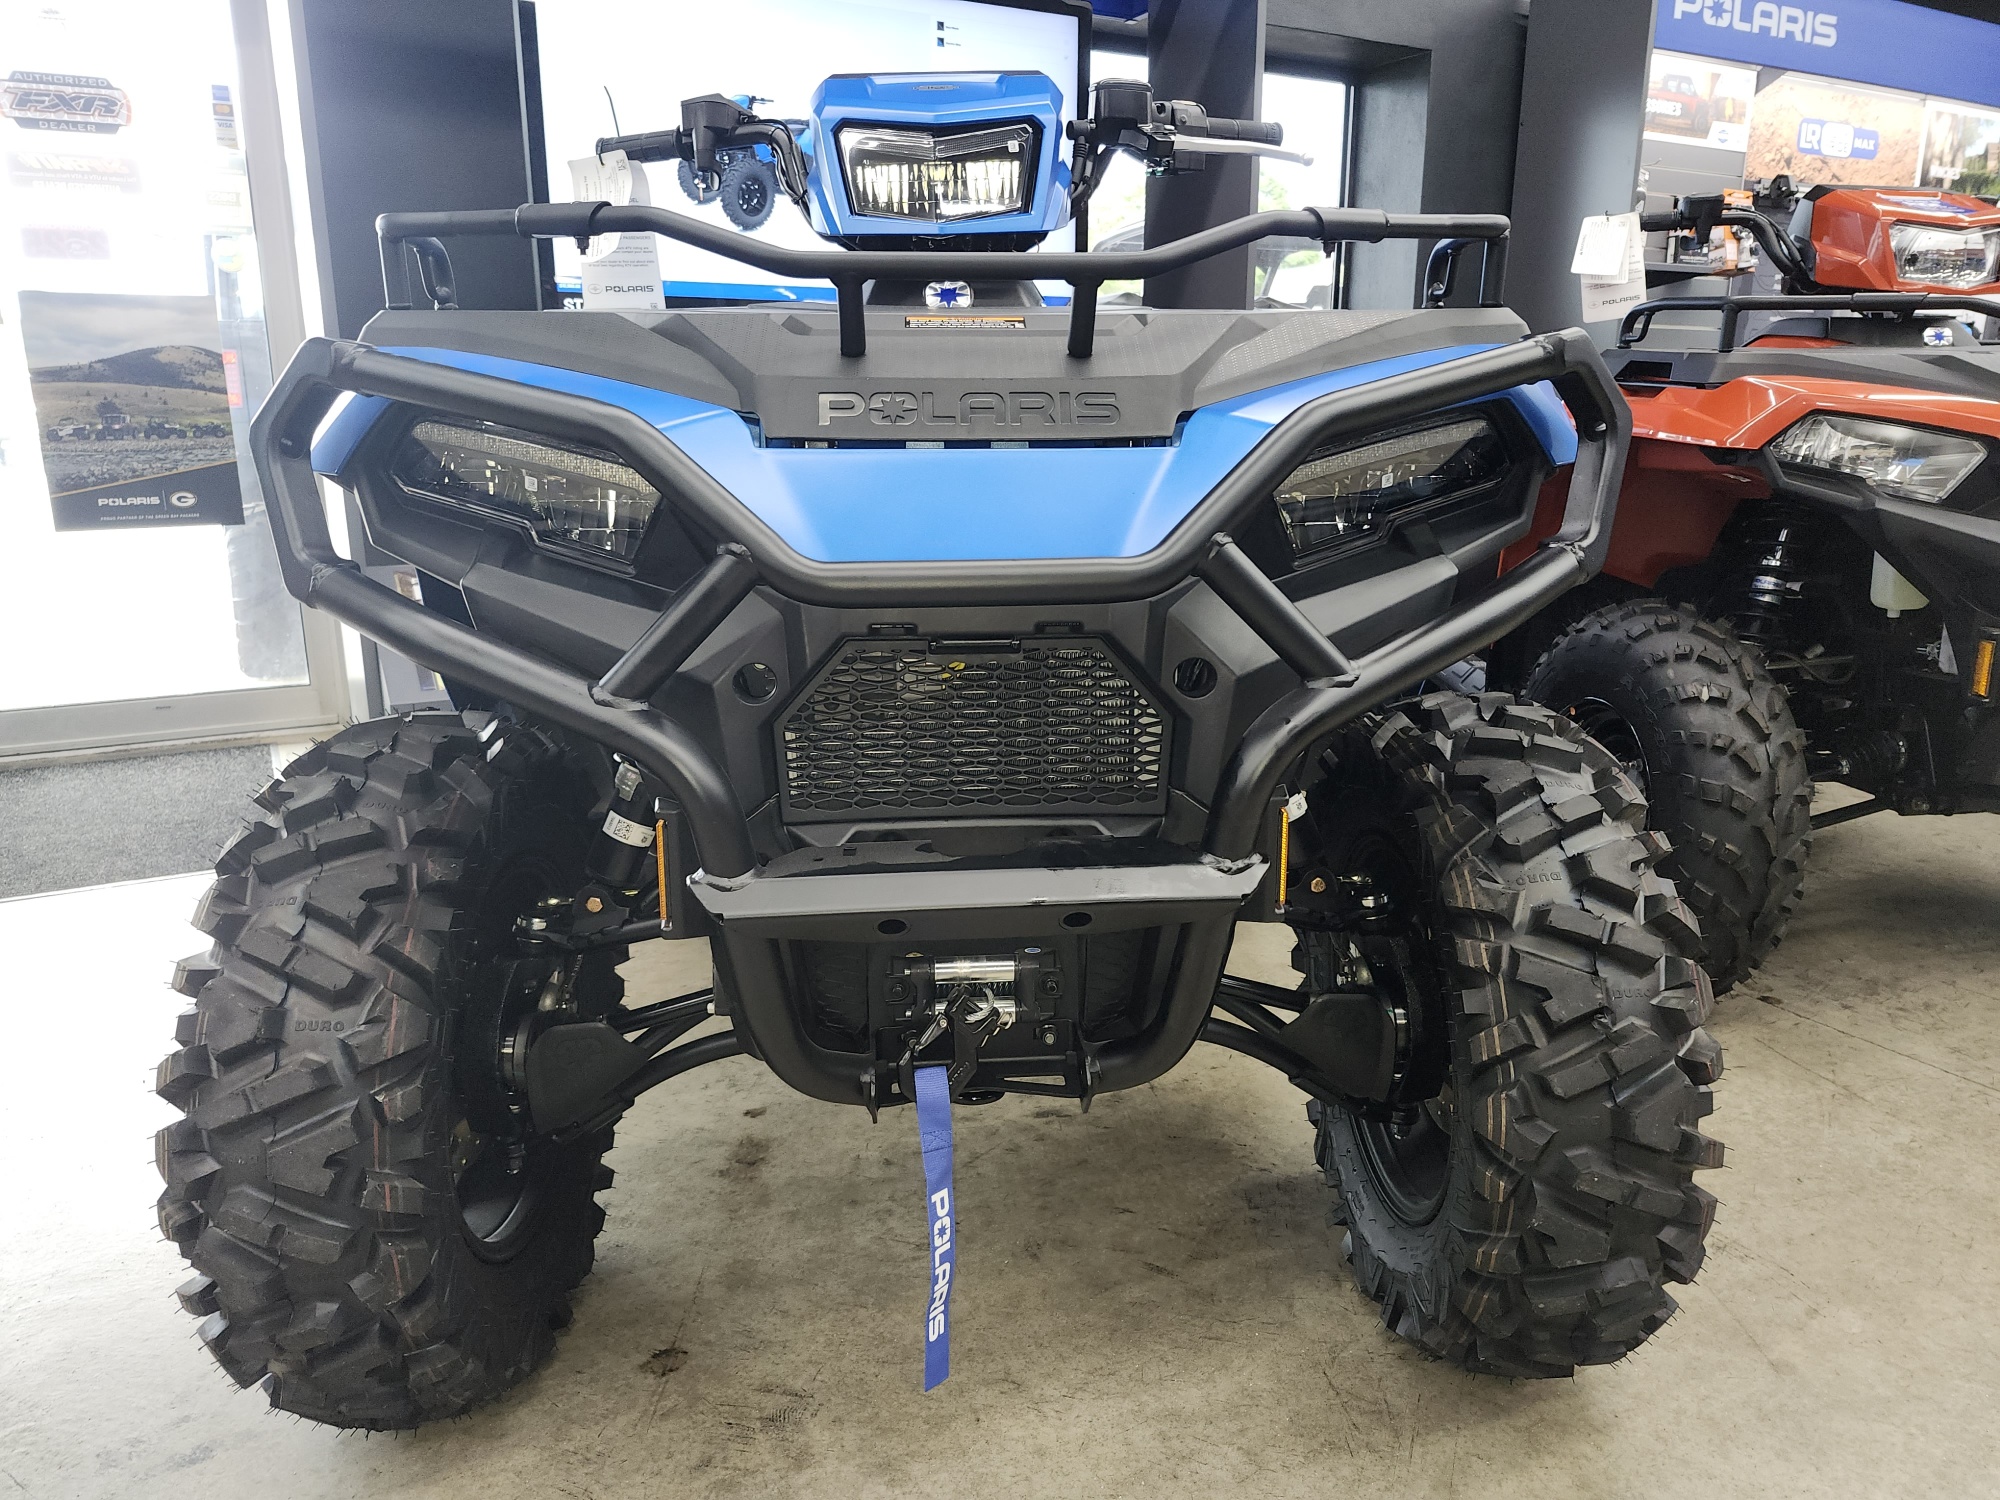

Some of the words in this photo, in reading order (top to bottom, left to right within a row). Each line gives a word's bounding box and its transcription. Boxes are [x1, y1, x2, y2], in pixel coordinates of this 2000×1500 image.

[1673, 0, 1838, 48] POLARIS
[13, 72, 108, 87] AUTHORIZED
[7, 88, 122, 117] FXR
[38, 121, 97, 132] DEALER
[217, 121, 234, 129] VISA
[1854, 137, 1876, 150] MAX
[605, 285, 654, 293] POLARIS
[1602, 294, 1641, 305] POLARIS
[818, 391, 1121, 426] POLARIS
[97, 496, 160, 507] POLARIS
[1515, 871, 1562, 886] DURO
[294, 1019, 345, 1032] DURO
[928, 1187, 951, 1343] POLARIS
